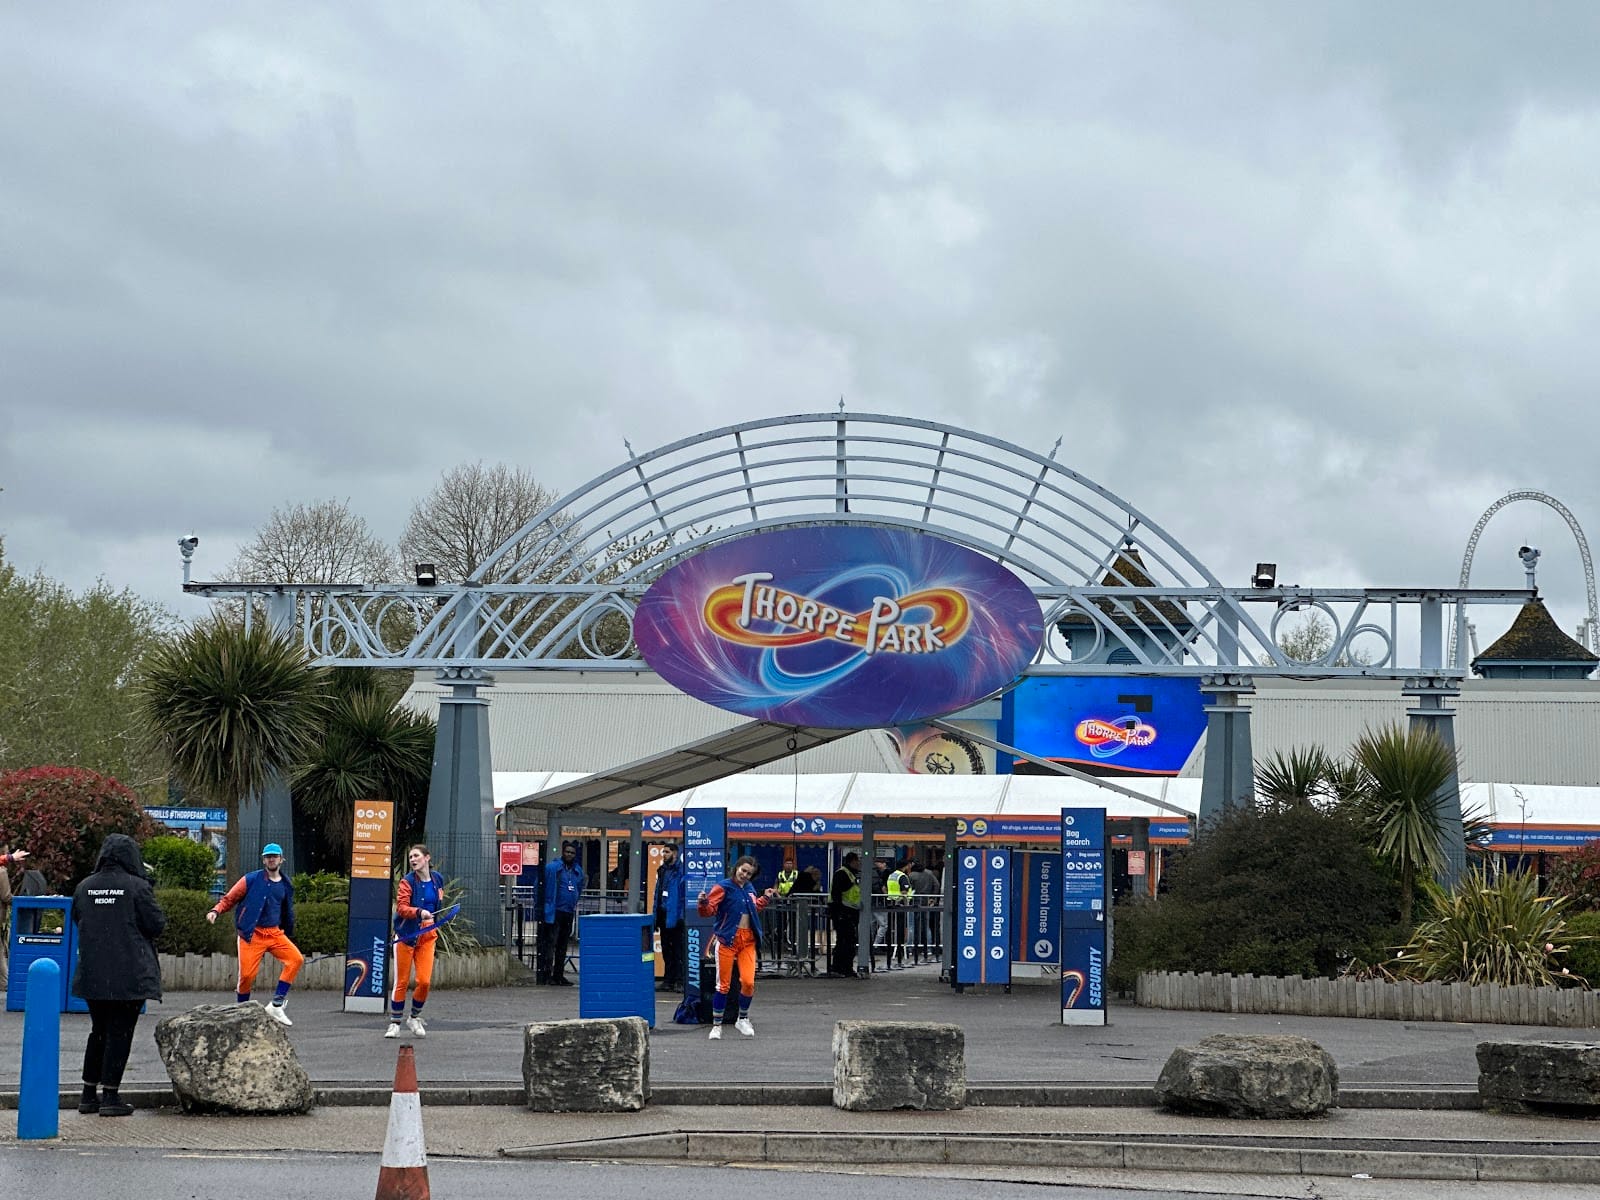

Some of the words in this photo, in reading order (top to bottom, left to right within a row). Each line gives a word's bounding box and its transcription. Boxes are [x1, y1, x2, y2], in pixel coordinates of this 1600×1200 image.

[732, 572, 857, 640] THORPE
[864, 596, 946, 654] PARK
[356, 823, 382, 832] Priority
[688, 830, 702, 838] Bag
[1066, 830, 1080, 839] Bag
[1066, 838, 1090, 846] search
[1041, 861, 1052, 880] Use
[94, 897, 116, 905] RESORT
[963, 878, 975, 914] search
[991, 878, 1003, 914] search
[1040, 882, 1051, 905] both
[963, 916, 977, 937] Bag
[991, 916, 1005, 937] Bag
[1039, 906, 1051, 934] lanes
[371, 936, 385, 994] SECURITY
[688, 928, 700, 989] SECURITY
[1089, 946, 1102, 1006] SECURITY
